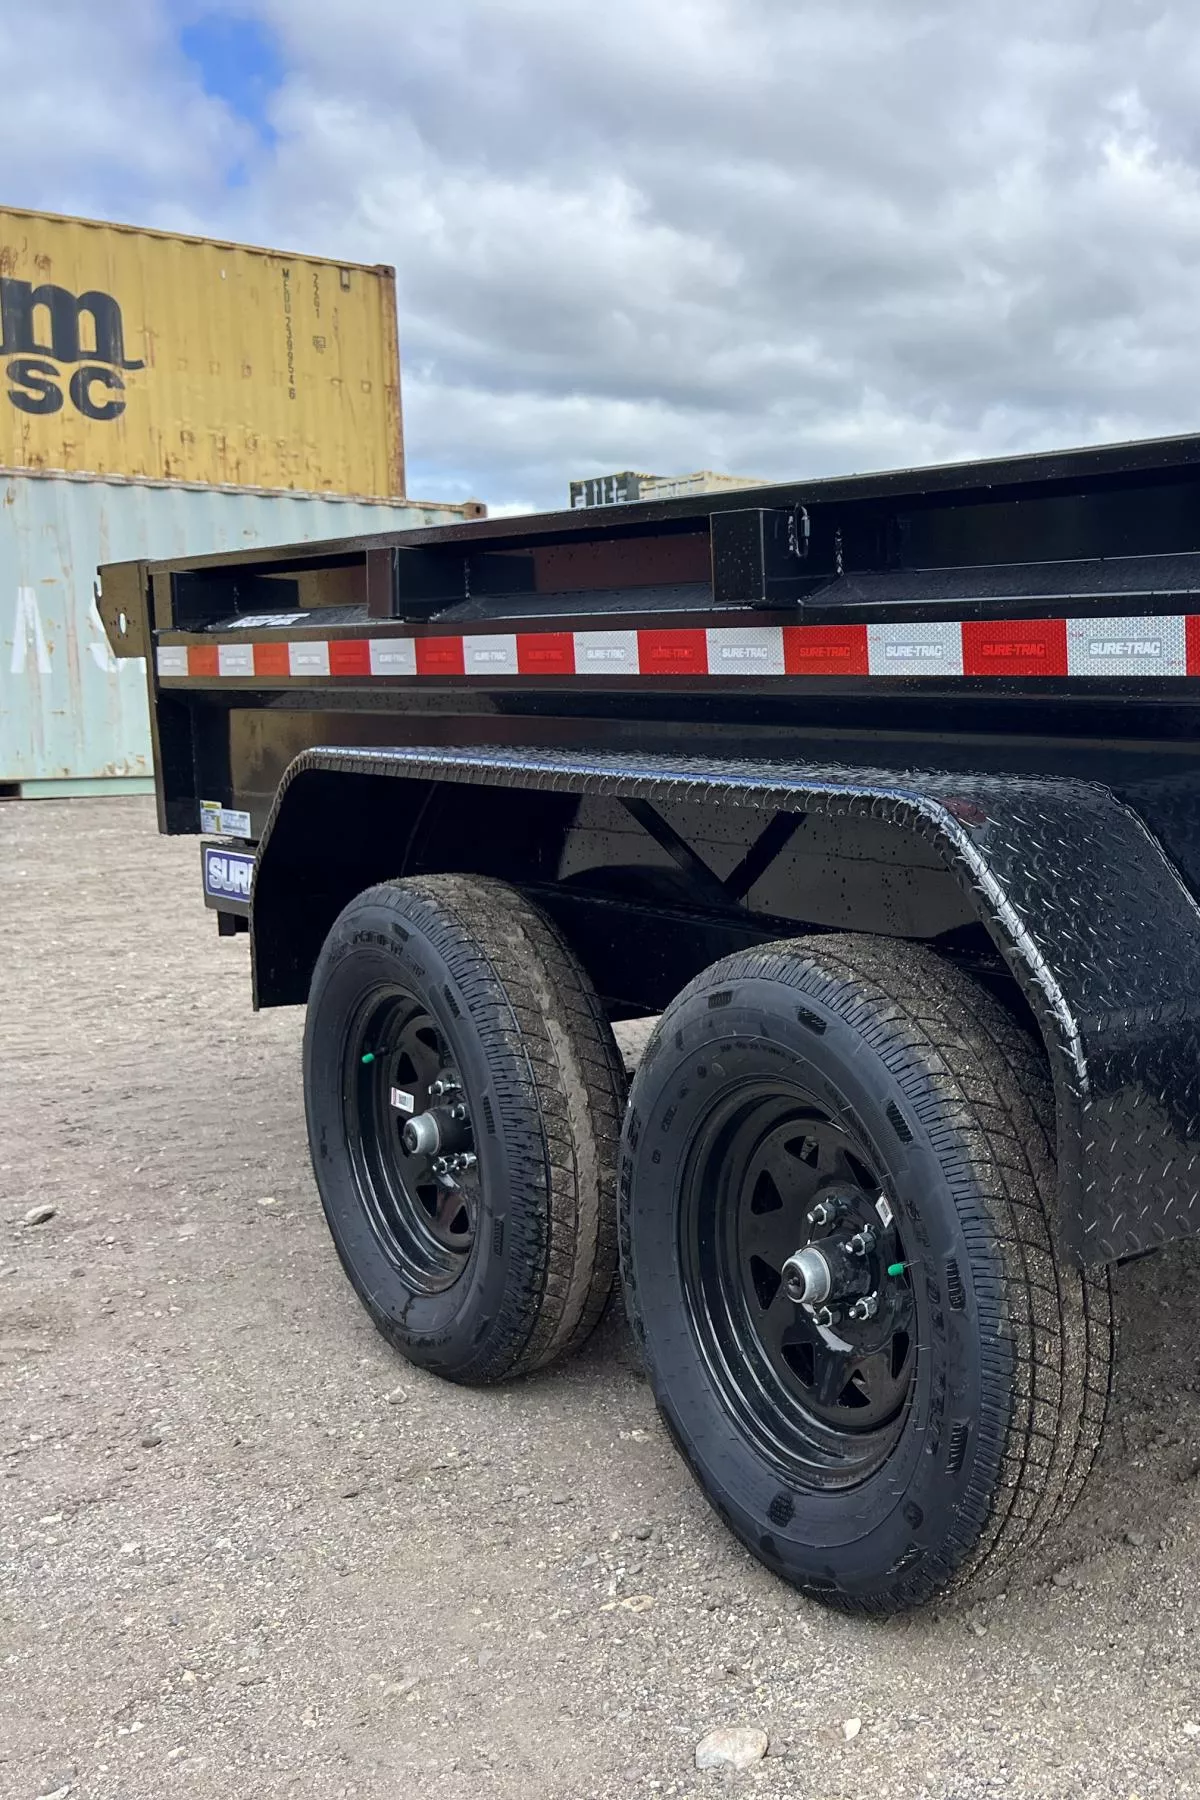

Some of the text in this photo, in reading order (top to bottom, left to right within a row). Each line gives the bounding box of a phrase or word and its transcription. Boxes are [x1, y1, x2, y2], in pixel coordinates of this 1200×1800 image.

[721, 646, 768, 659] SURE-TRAC
[886, 644, 943, 658] SURE-TRAC
[982, 642, 1046, 657] SURE-TRAC
[1089, 641, 1162, 656] SURE-TRAC
[209, 857, 253, 895] SUR
